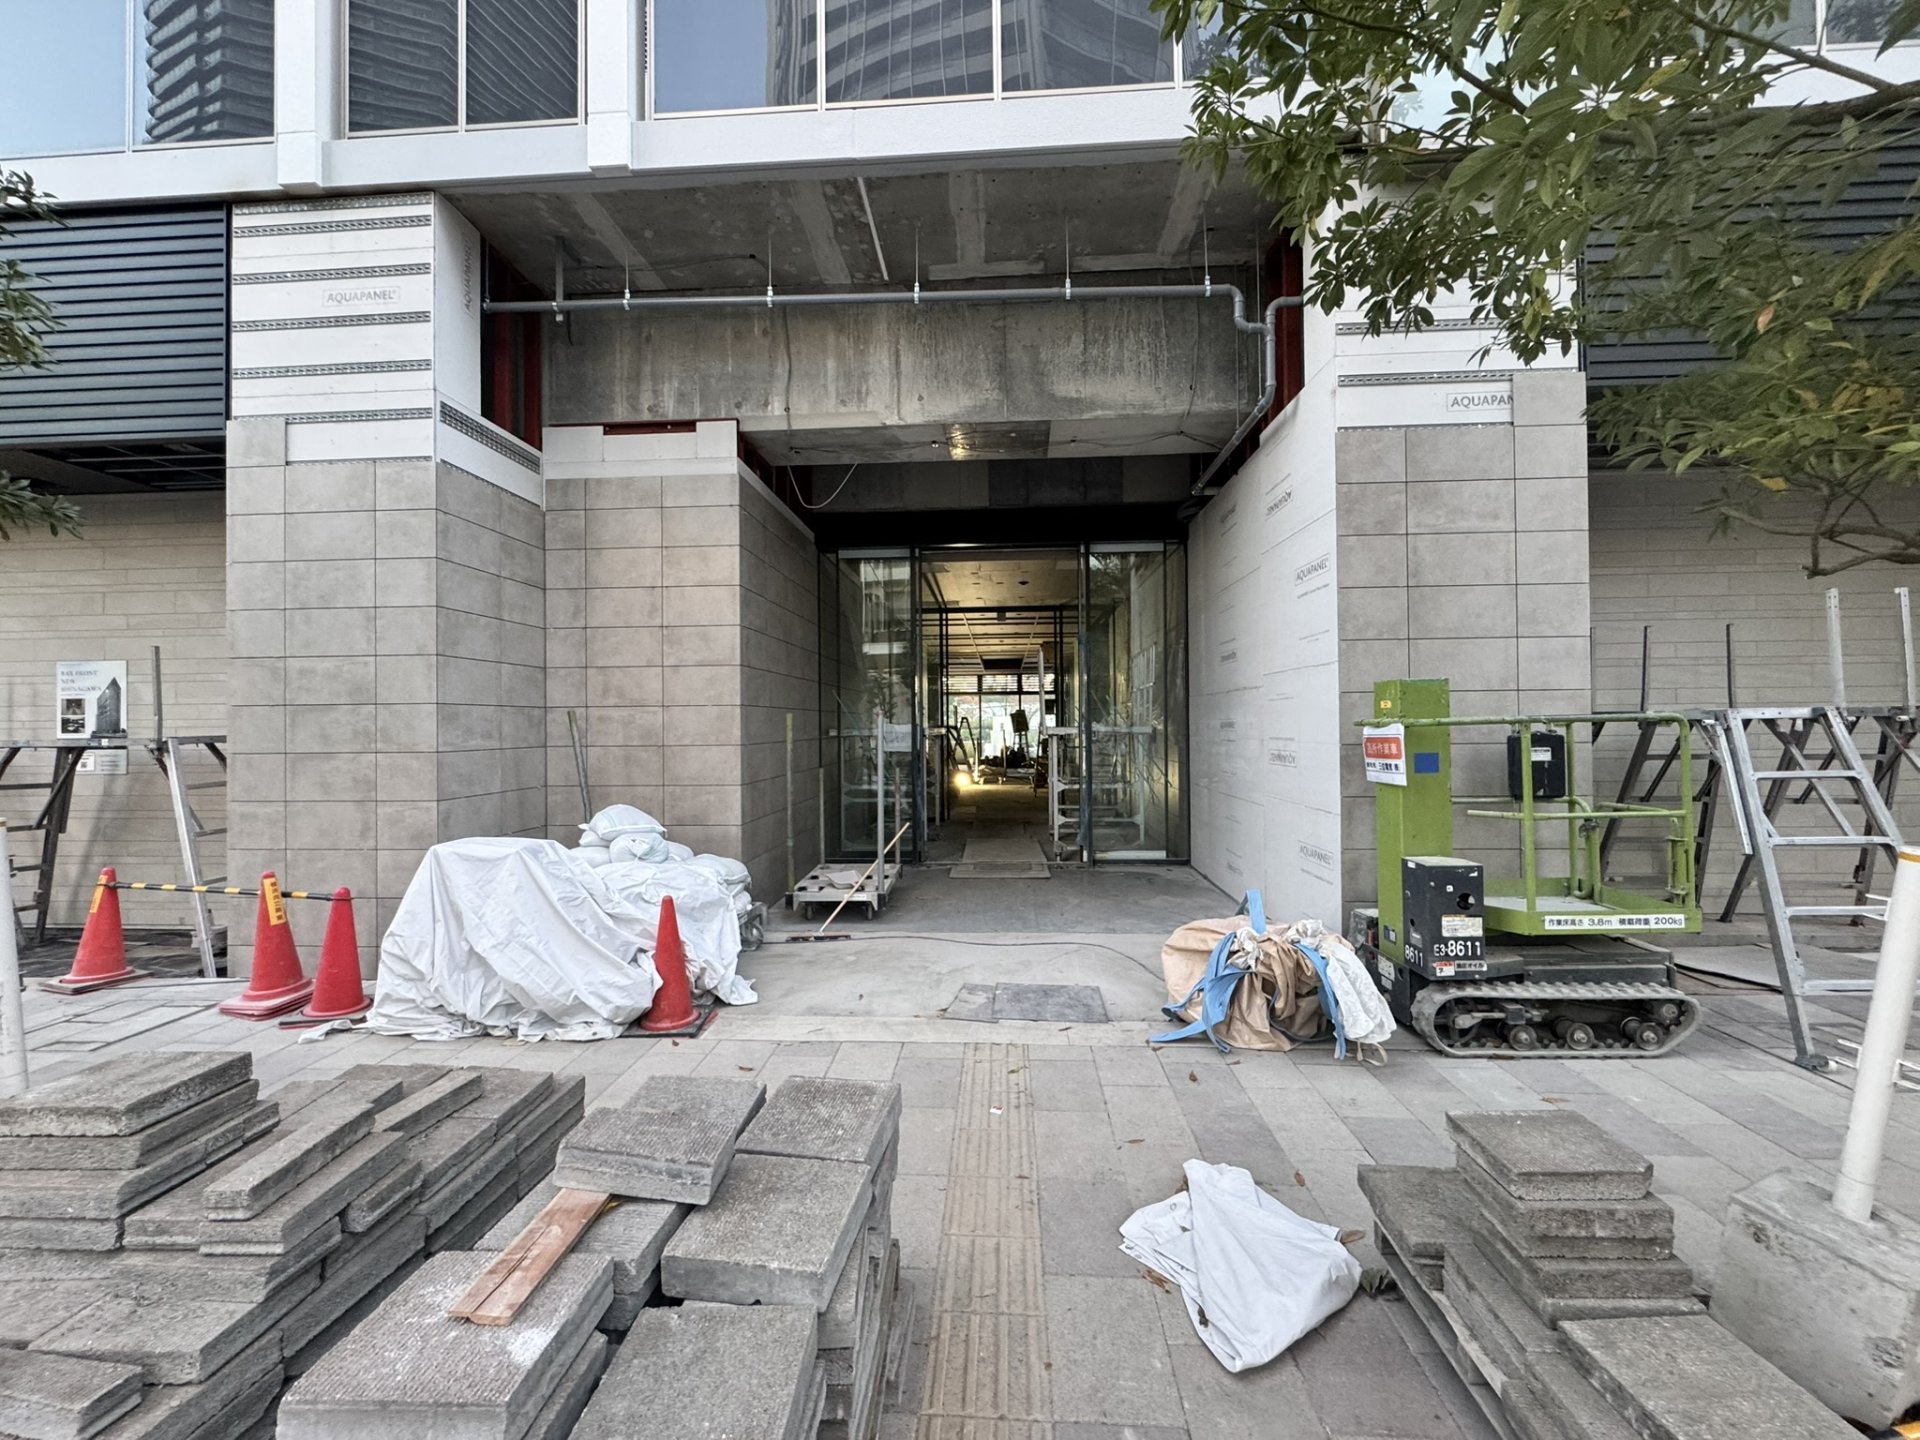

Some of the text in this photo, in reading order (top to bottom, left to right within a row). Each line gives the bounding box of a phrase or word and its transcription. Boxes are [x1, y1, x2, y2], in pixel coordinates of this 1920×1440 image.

[1588, 918, 1612, 926] 3.8m
[1654, 916, 1683, 926] 200kg
[1405, 944, 1423, 968] 8611
[1434, 940, 1481, 956] E3-8611
